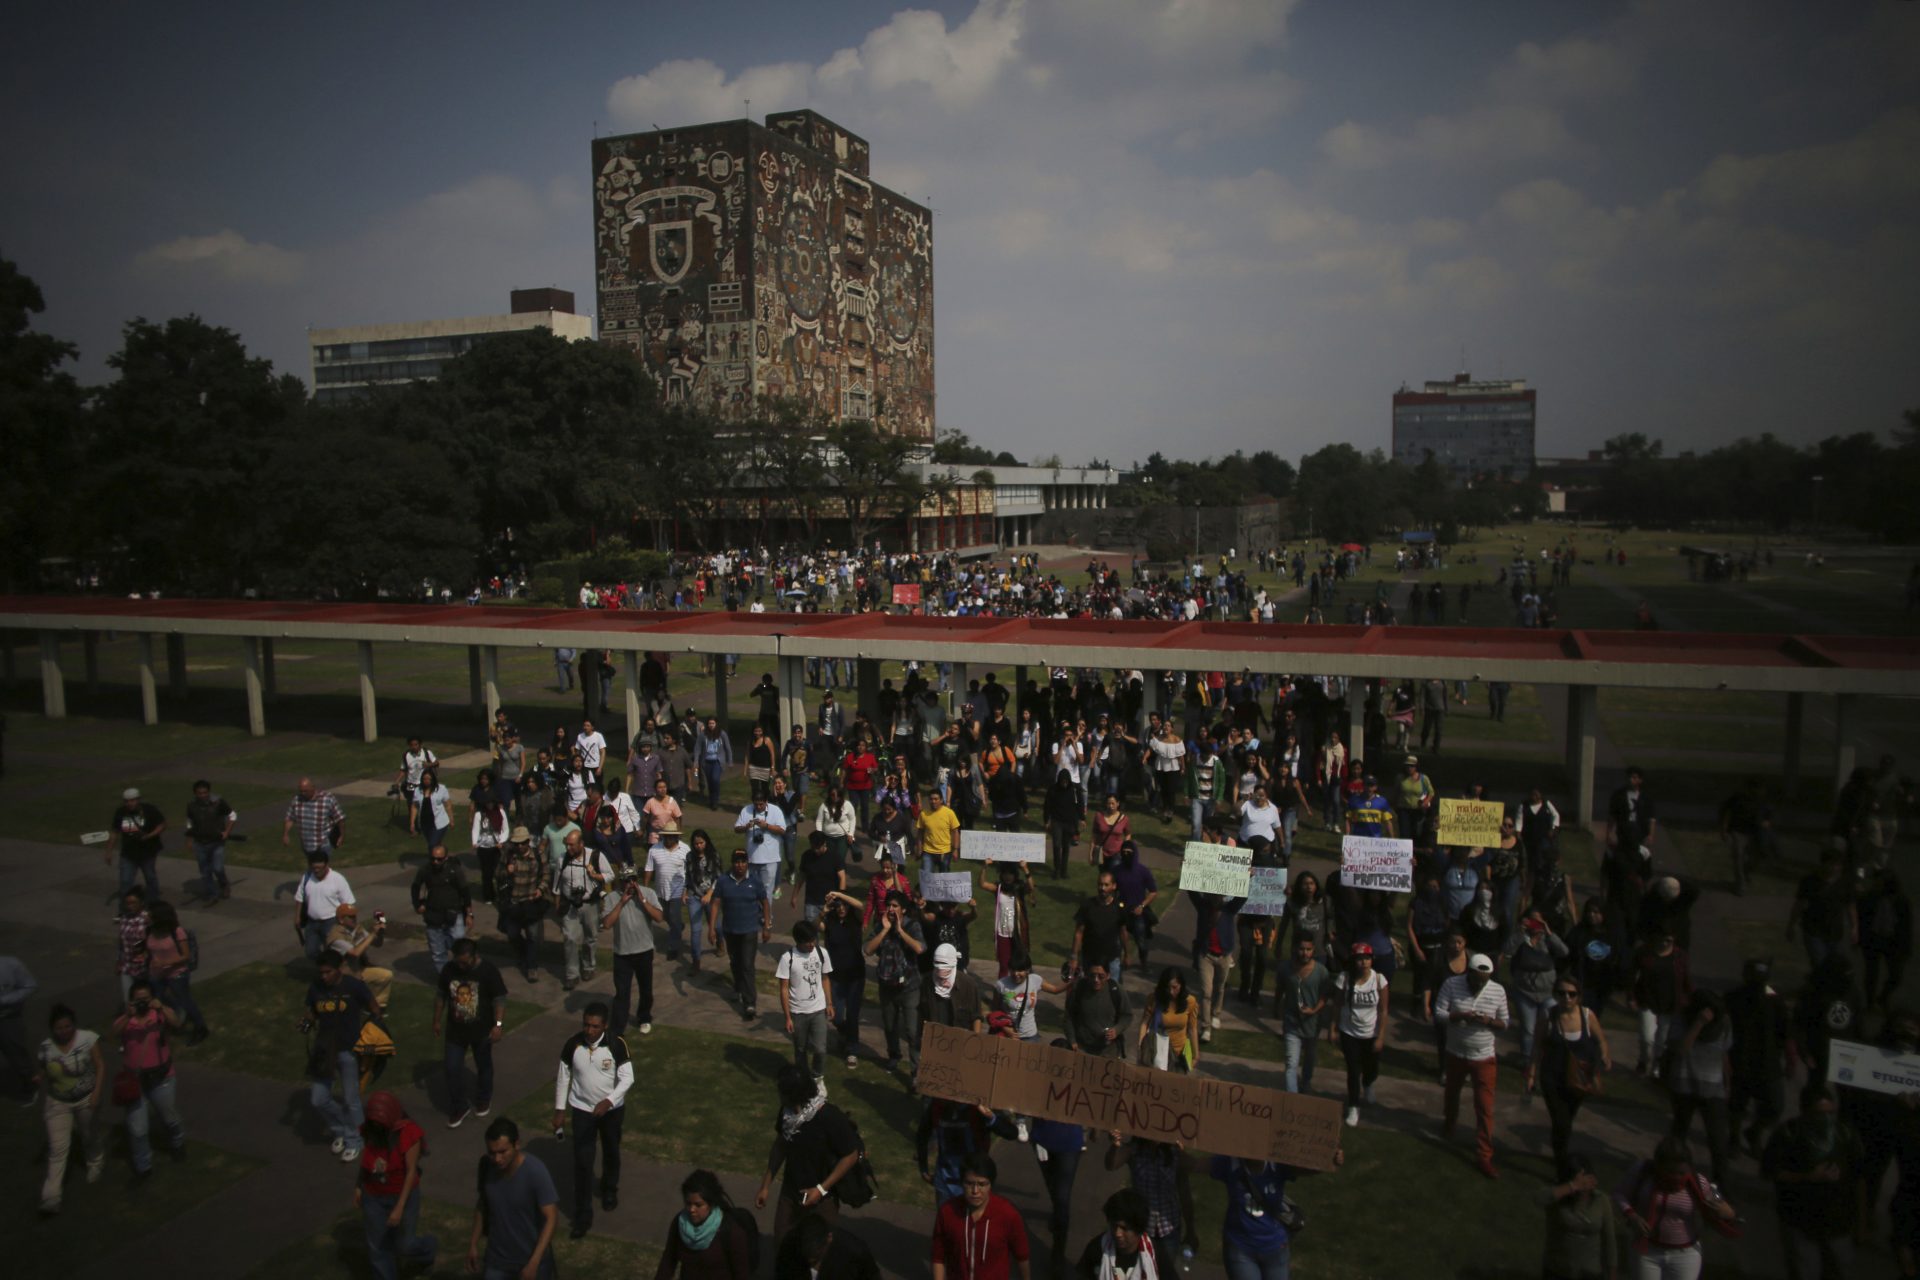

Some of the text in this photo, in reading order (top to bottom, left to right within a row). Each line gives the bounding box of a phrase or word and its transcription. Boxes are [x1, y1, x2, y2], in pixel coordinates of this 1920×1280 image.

[1217, 853, 1252, 866] DIGNIDAD
[1370, 856, 1400, 866] PINCHE
[1353, 873, 1411, 889] PROTESTAR
[929, 1023, 958, 1053] Por
[1046, 1081, 1199, 1140] MATANDO
